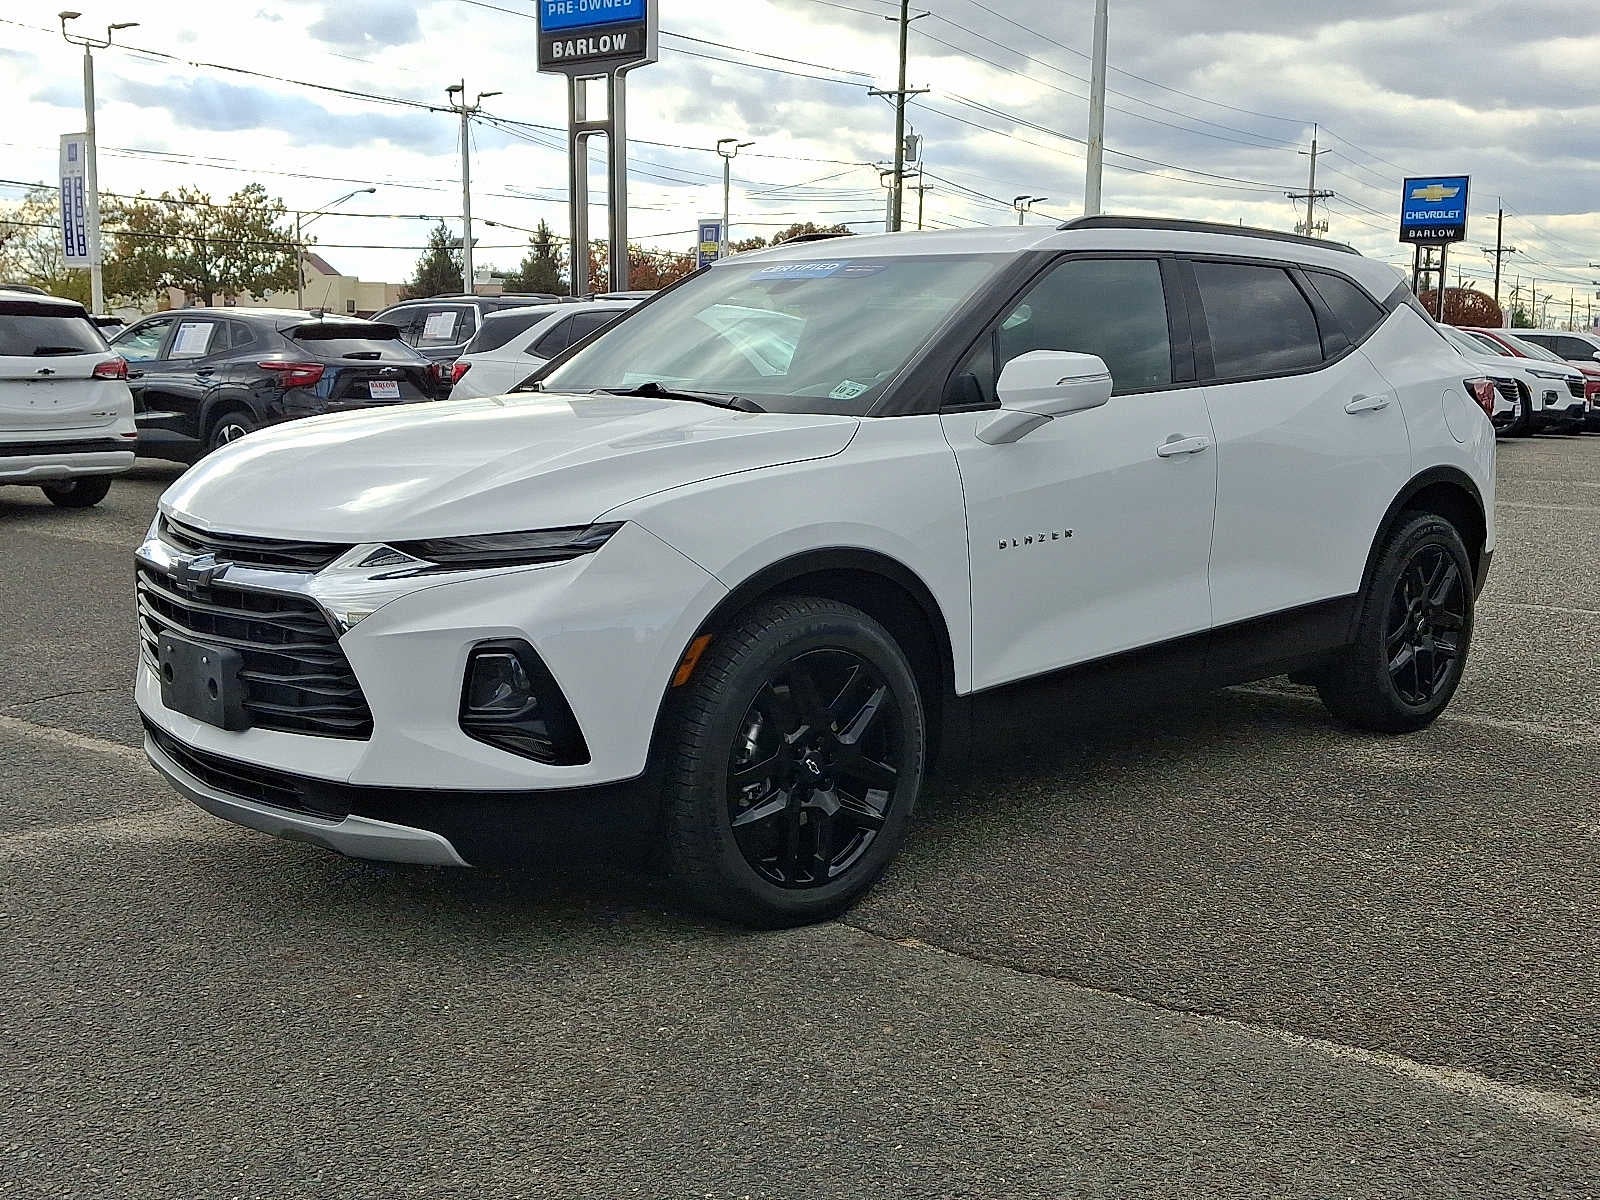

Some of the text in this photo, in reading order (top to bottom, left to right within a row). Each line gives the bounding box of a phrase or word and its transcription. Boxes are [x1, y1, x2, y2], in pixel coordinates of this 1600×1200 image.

[548, 0, 631, 16] PRE-OWNED
[552, 33, 627, 58] BARLOW
[1405, 210, 1460, 220] CHEVROLET
[1408, 229, 1455, 238] BARLOW
[998, 528, 1073, 550] BLAZER
